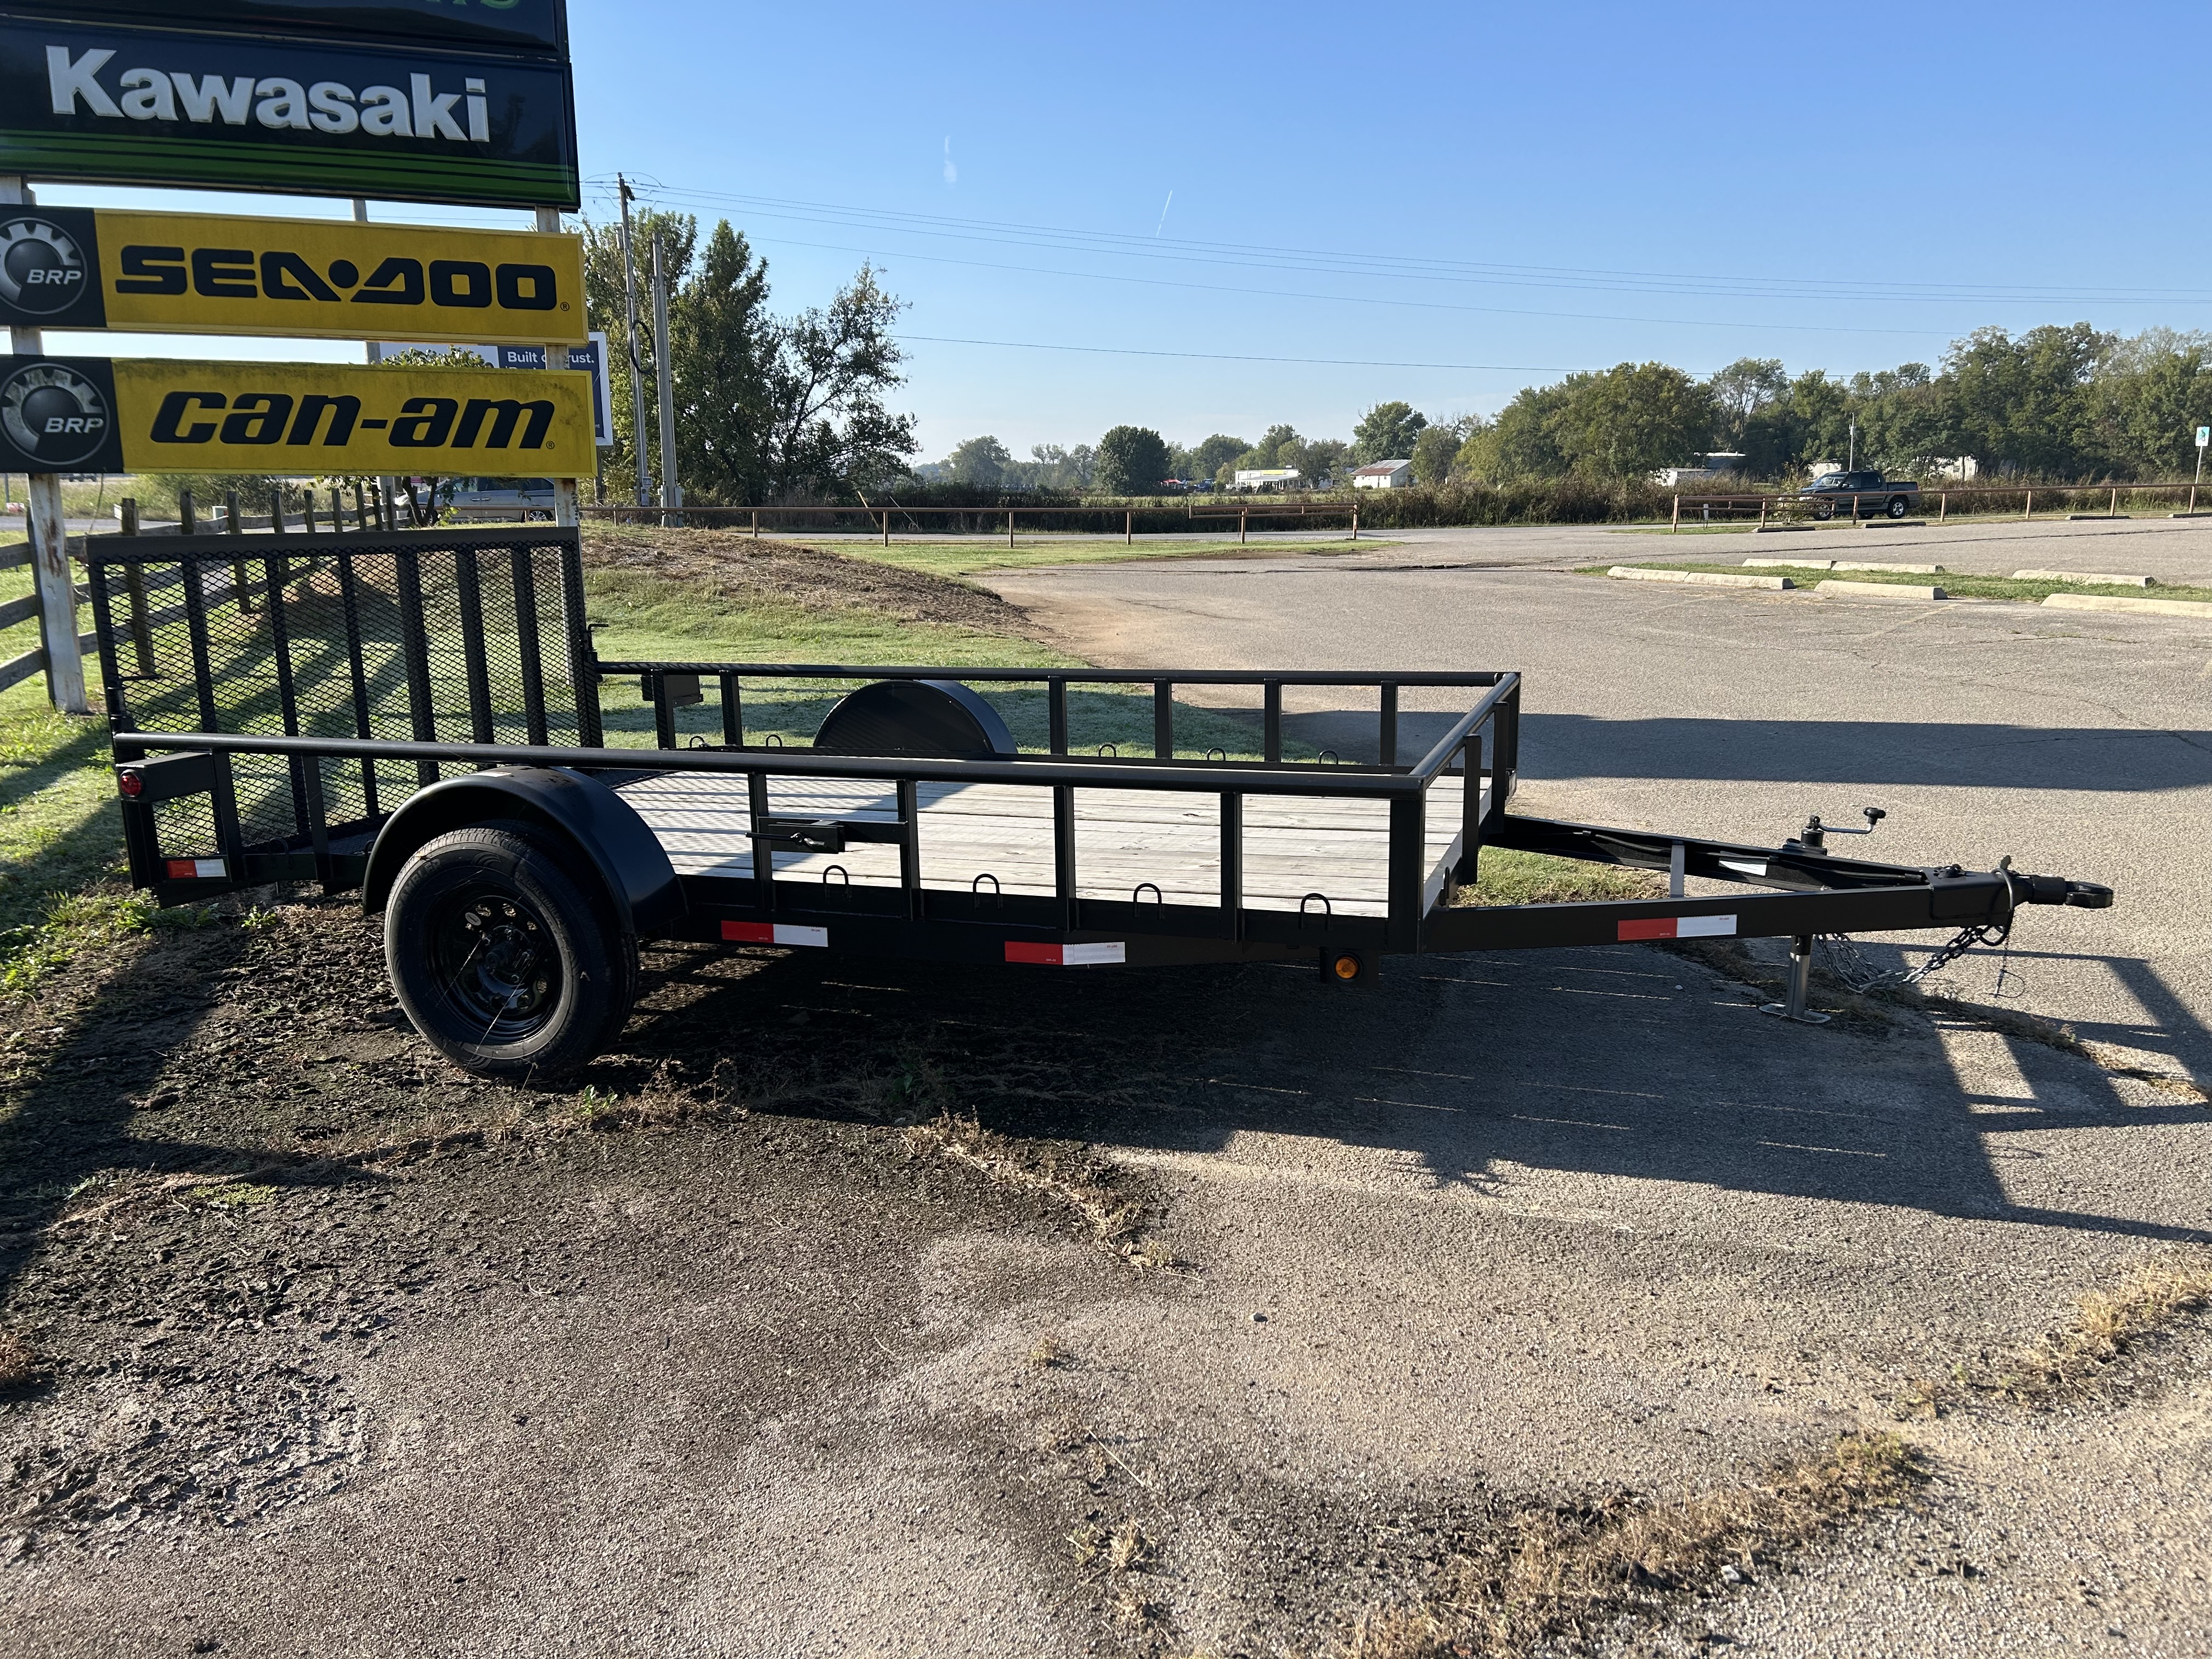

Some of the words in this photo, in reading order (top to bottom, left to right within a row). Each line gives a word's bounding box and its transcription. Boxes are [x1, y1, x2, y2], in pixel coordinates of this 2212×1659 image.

[46, 46, 489, 142] Kawasaki
[27, 268, 82, 285] BRP
[507, 351, 537, 363] Built
[44, 417, 104, 434] BRP
